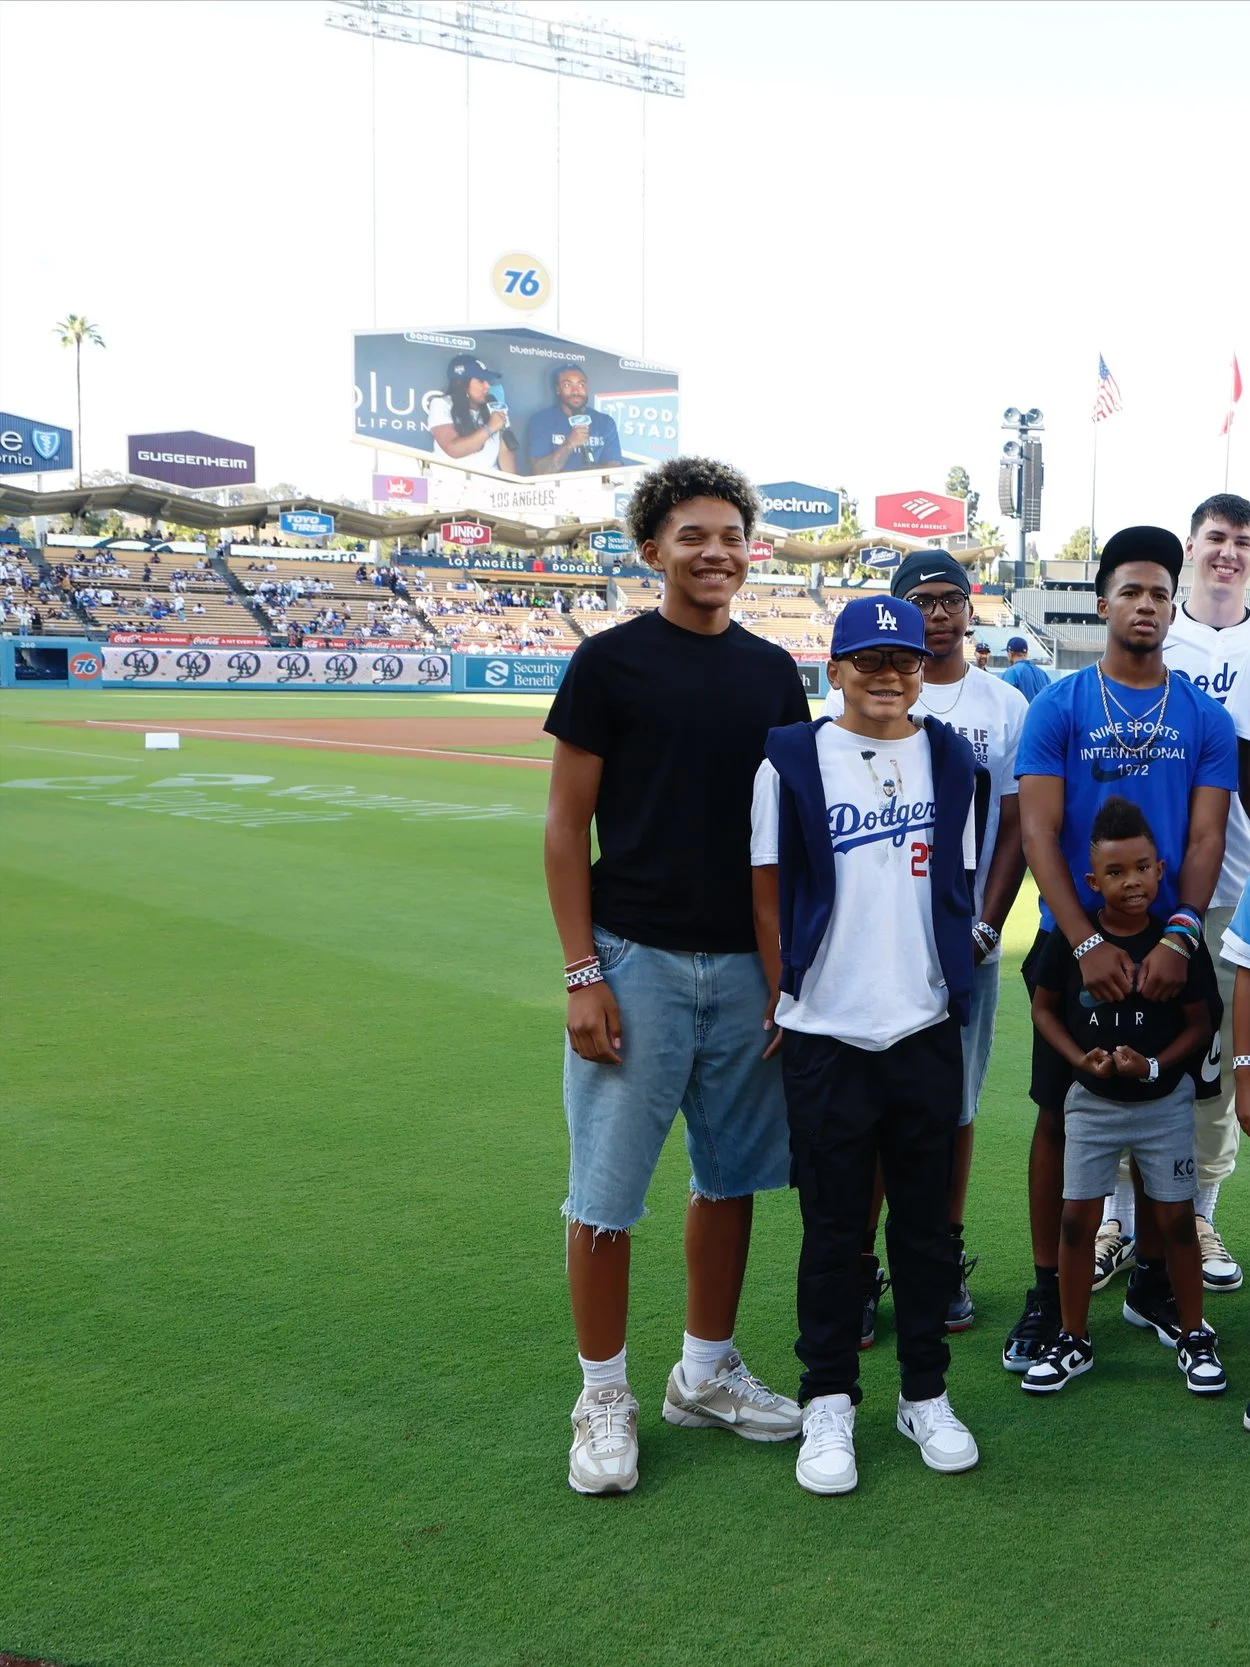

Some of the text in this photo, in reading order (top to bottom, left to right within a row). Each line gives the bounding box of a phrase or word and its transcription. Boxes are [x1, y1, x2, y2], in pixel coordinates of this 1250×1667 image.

[505, 270, 540, 297] 76
[628, 407, 681, 422] DOD
[138, 450, 248, 469] GUGGENHEIM
[287, 514, 320, 523] TOYO
[893, 521, 910, 530] BANK
[911, 522, 919, 530] OF
[292, 522, 328, 533] TIRES
[449, 525, 485, 541] JINRO
[449, 558, 604, 576] LOS ANGELES DODGERS
[875, 604, 897, 631] LA
[74, 659, 97, 674] 76
[514, 662, 562, 676] Security
[514, 674, 554, 687] Benefit
[973, 728, 989, 742] IF
[1089, 722, 1124, 742] NIKE
[1127, 721, 1180, 741] SPORTS
[1080, 746, 1186, 760] INTERNATIONAL
[1117, 763, 1149, 776] 1972
[828, 796, 936, 847] Dodger
[911, 842, 934, 878] 2
[1089, 1011, 1145, 1026] AIR
[1174, 1158, 1194, 1177] KC
